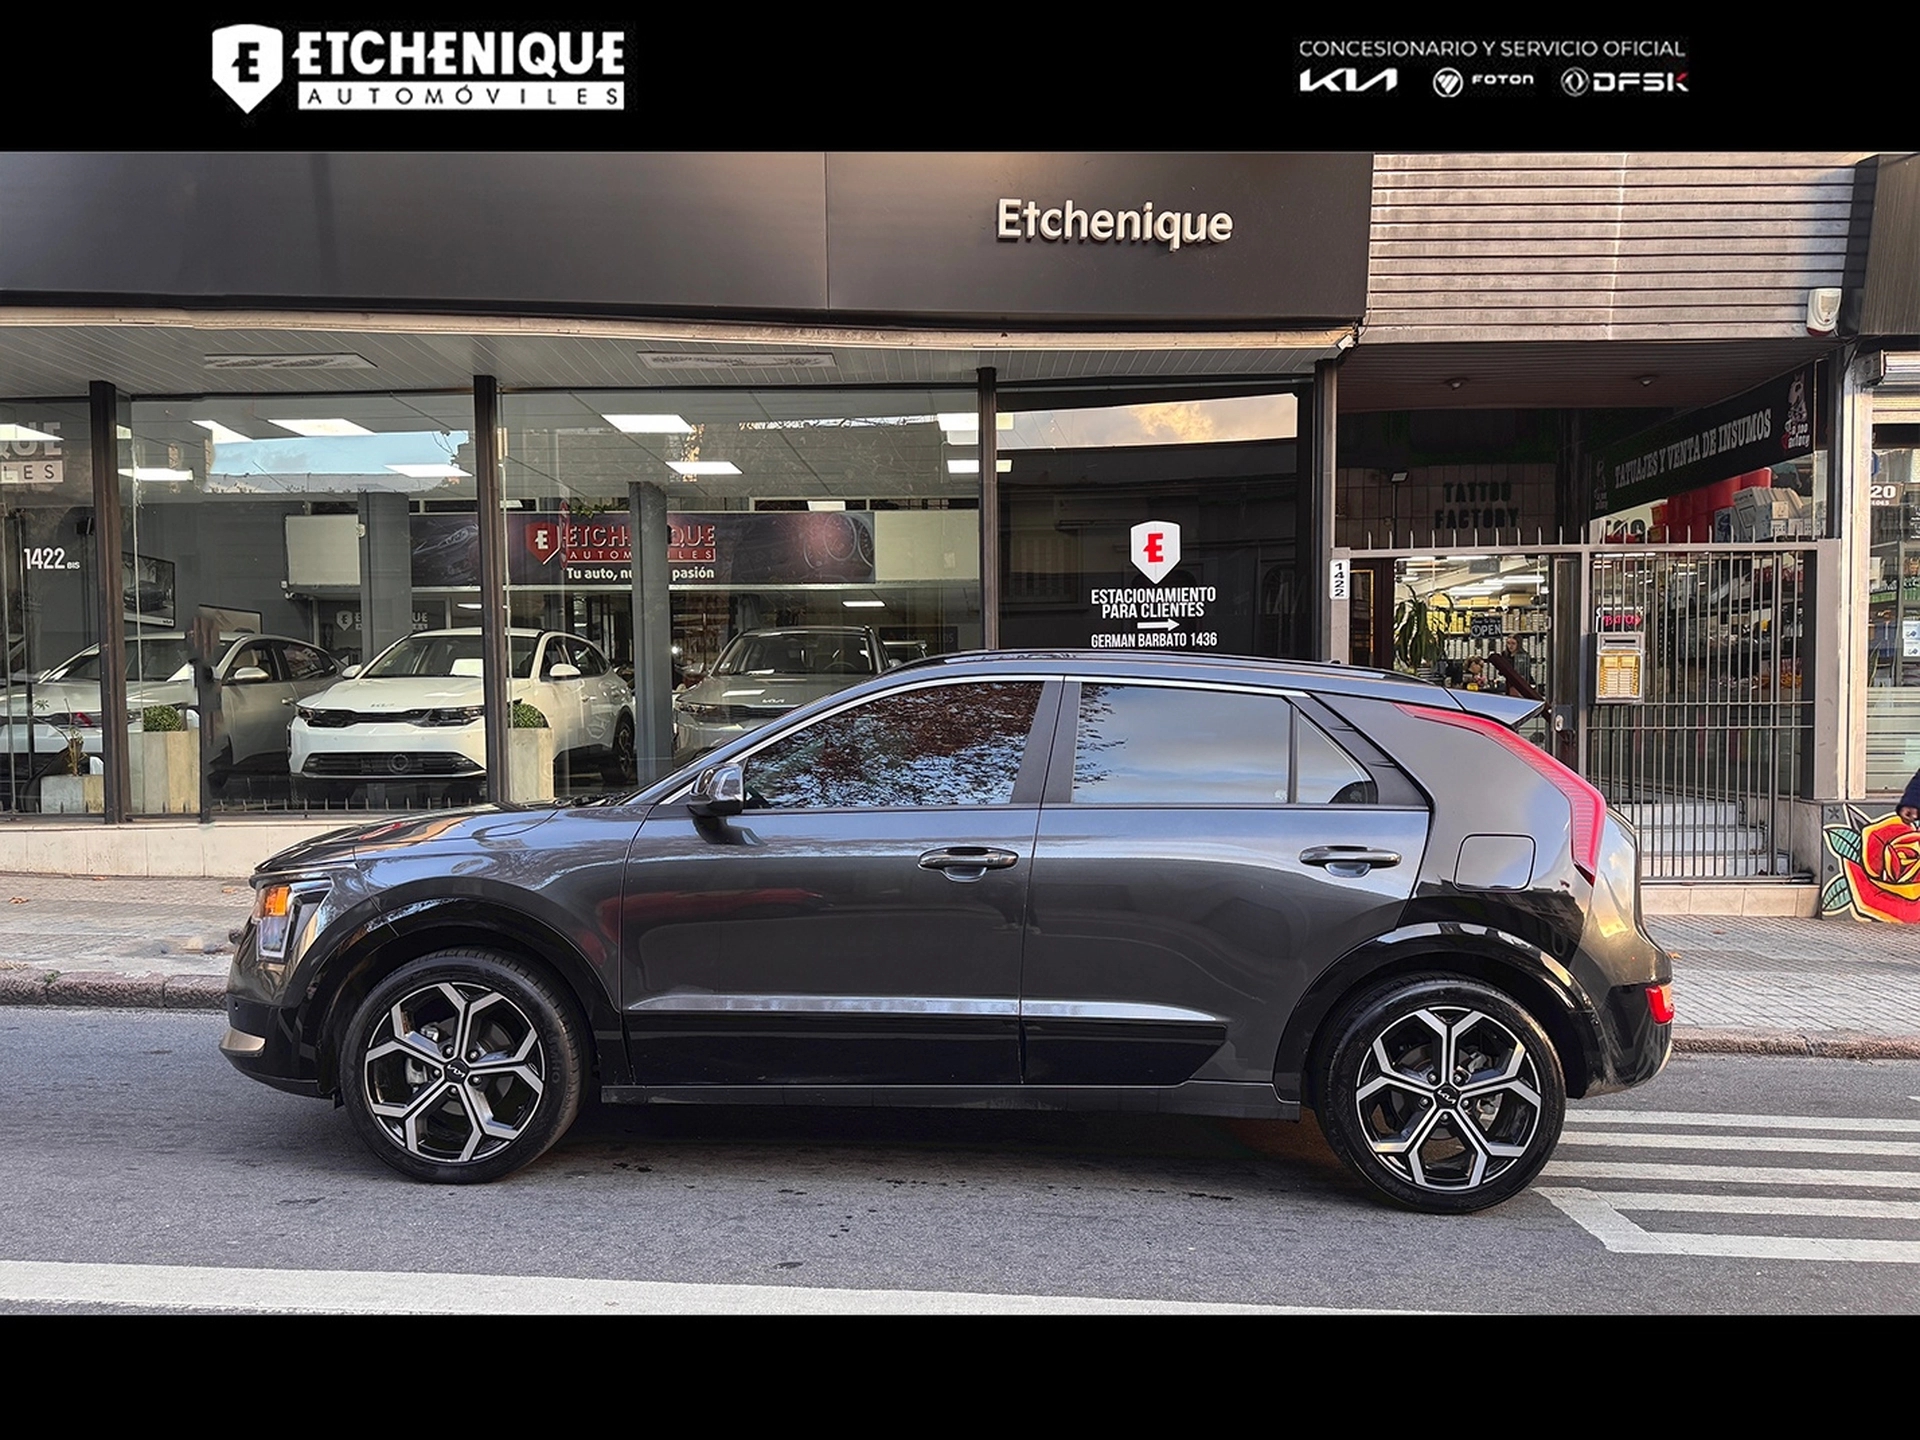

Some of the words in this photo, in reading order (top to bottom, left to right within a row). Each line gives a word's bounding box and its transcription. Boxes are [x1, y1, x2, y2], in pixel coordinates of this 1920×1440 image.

[997, 198, 1234, 252] Etchenique
[1614, 453, 1659, 489] TATUAJES
[1657, 447, 1667, 474] Y
[1667, 434, 1701, 471] VENTA
[1702, 429, 1717, 460] DE
[1717, 408, 1772, 452] INSUMOS
[1443, 481, 1512, 503] TATTOO
[1434, 508, 1519, 529] FACTORY
[23, 547, 66, 570] 1422
[566, 568, 582, 579] Tu
[584, 568, 618, 581] auto,
[672, 566, 715, 581] pasión
[1333, 562, 1345, 598] 1422
[1091, 586, 1217, 605] ESTACIONAMIENTO
[1102, 603, 1138, 619] PARA
[1140, 602, 1205, 618] CLIENTES
[1091, 633, 1136, 648] GERMAN
[1138, 632, 1187, 647] BARBATO
[1190, 631, 1218, 647] 1436
[1470, 623, 1502, 638] OPEN
